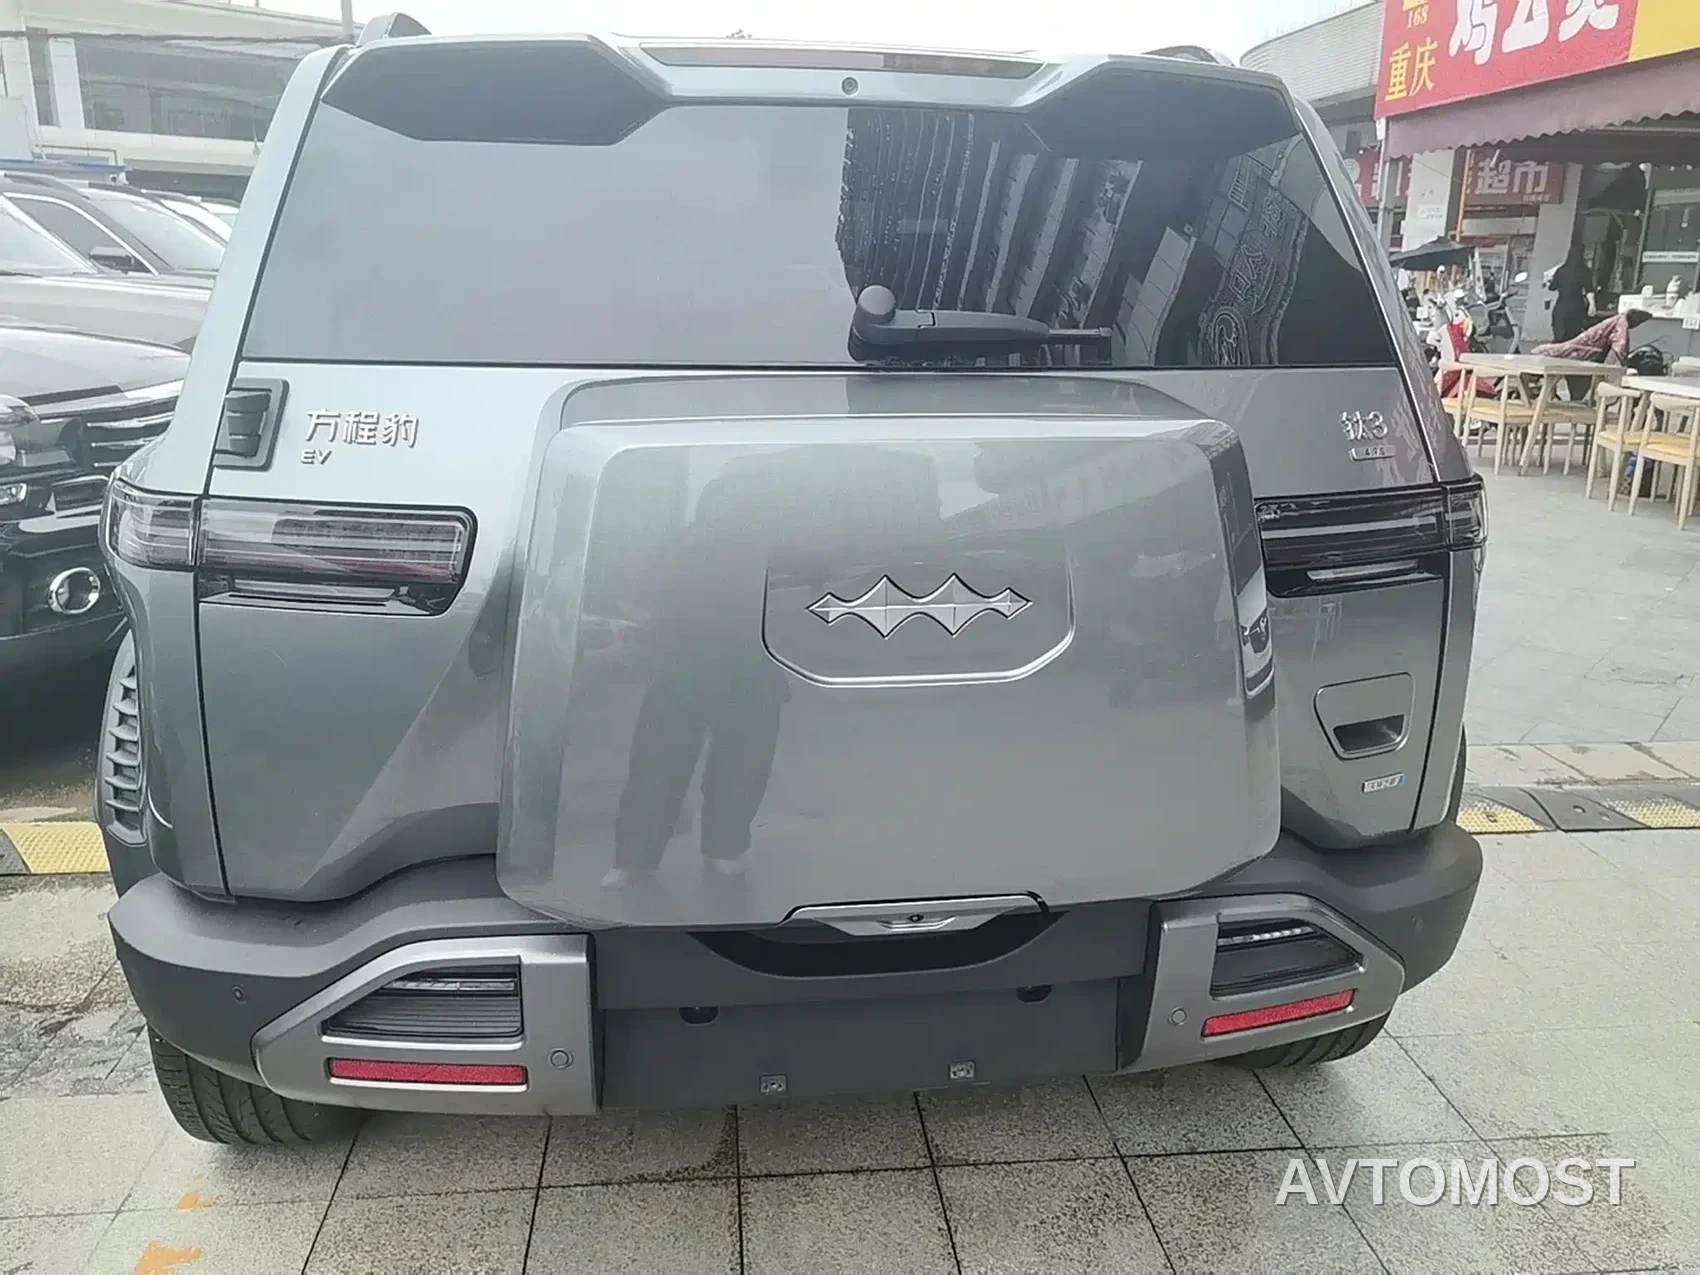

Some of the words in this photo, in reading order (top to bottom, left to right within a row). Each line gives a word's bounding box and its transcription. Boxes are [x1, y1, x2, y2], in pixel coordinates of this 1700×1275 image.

[1407, 3, 1430, 29] 168
[1385, 36, 1438, 101] 重庆
[1474, 158, 1549, 194] 超市
[305, 408, 419, 449] 方程豹
[300, 449, 333, 466] EV
